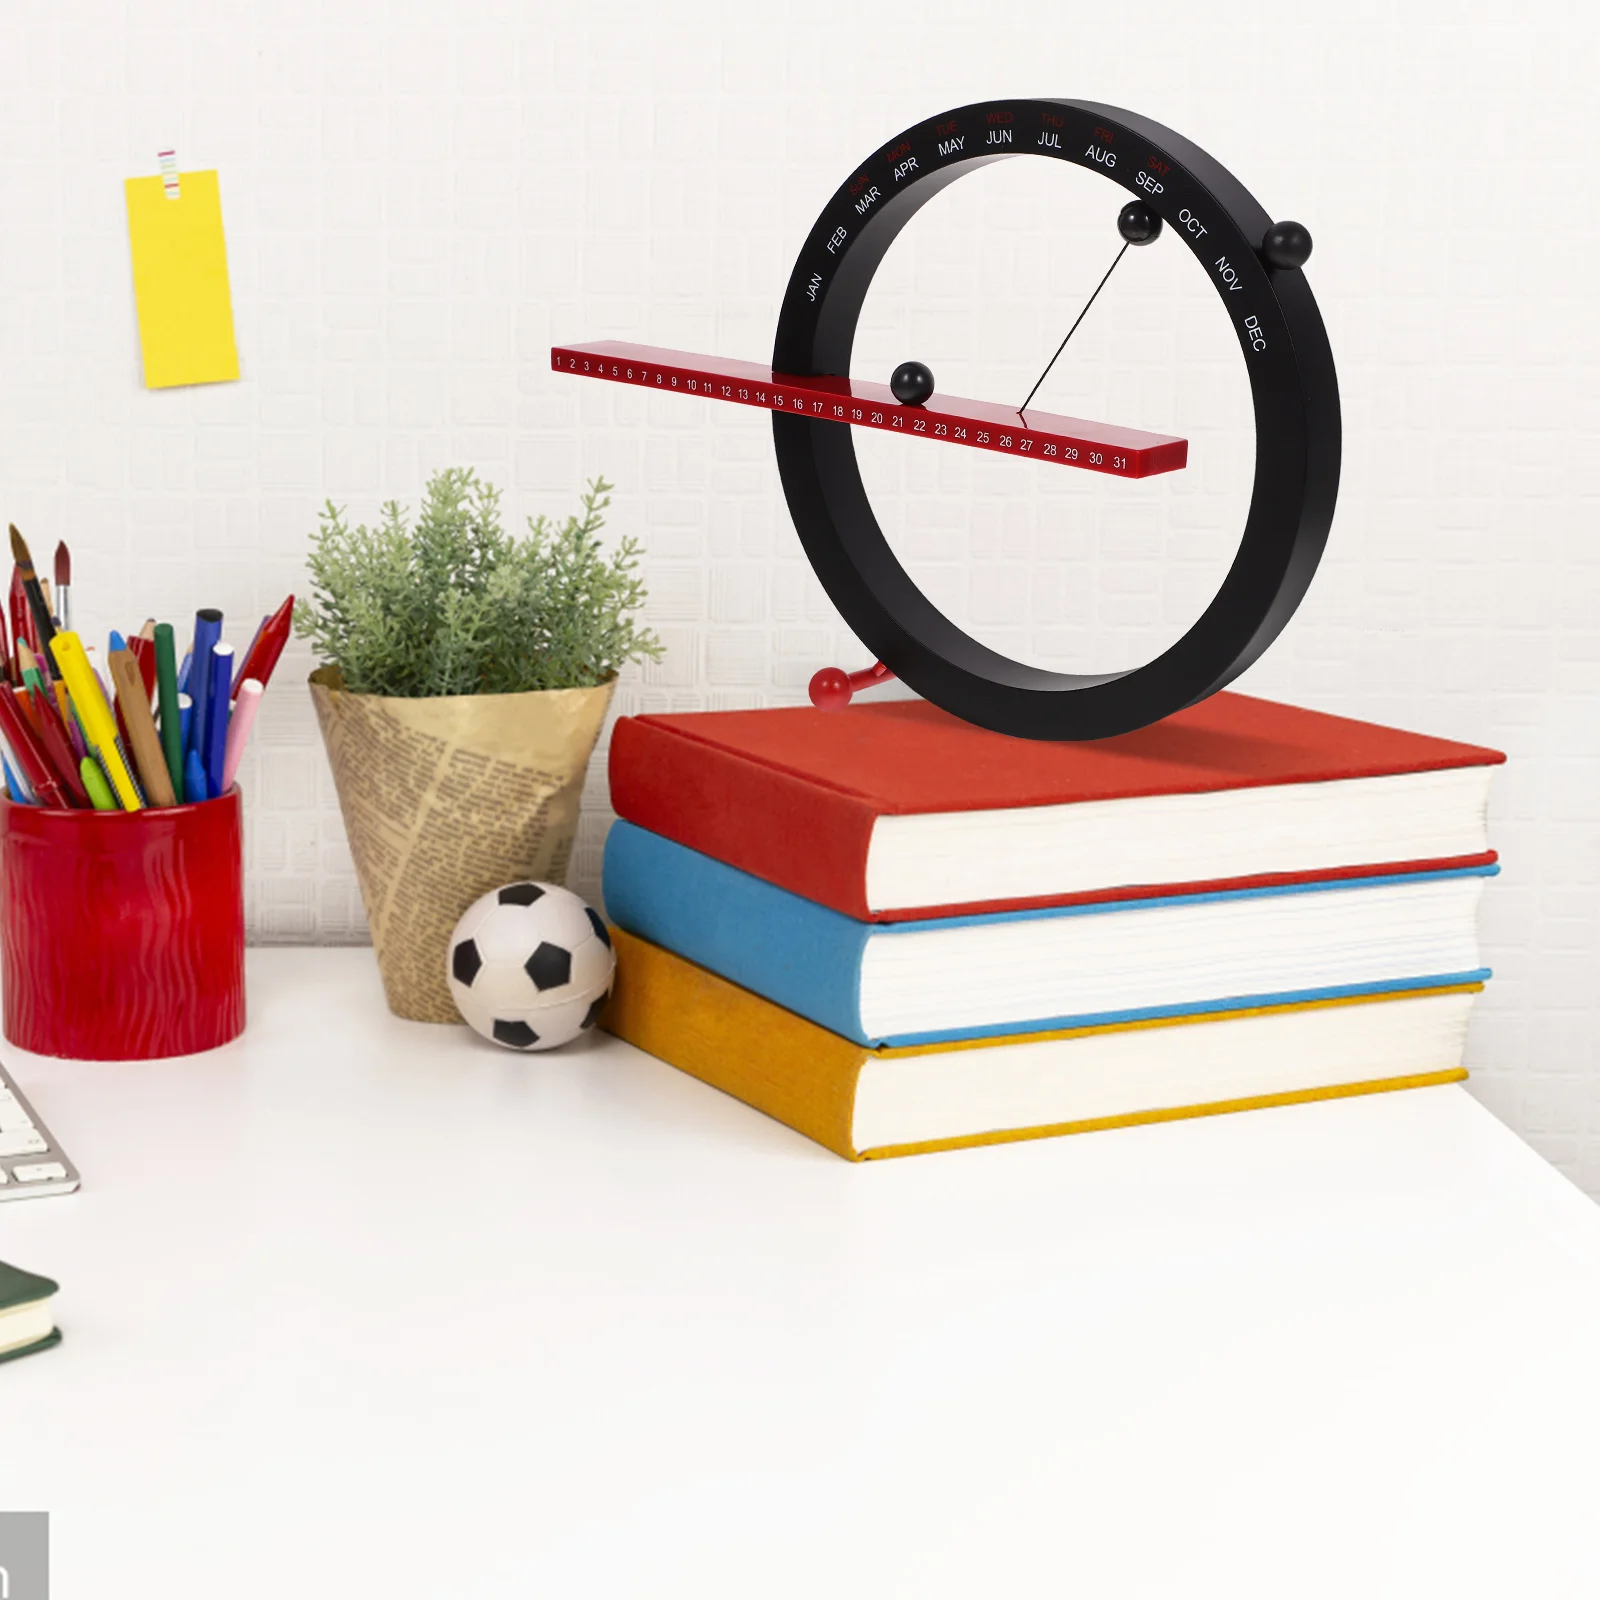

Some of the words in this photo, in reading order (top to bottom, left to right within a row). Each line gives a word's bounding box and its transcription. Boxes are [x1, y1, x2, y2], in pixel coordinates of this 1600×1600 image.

[849, 175, 870, 197] SUN
[886, 142, 911, 162] MON
[935, 119, 957, 135] TUE
[985, 111, 1013, 124] WED
[1041, 113, 1065, 128] THU
[1093, 127, 1115, 144] FRI
[1147, 155, 1170, 176] SAT
[806, 272, 823, 302] JAN
[826, 226, 847, 254] FEB
[854, 186, 882, 215] MAR
[894, 156, 920, 182] APR
[937, 135, 965, 157] MAY
[986, 129, 1012, 145] JUN
[1037, 131, 1062, 149] JUL
[1084, 144, 1117, 168] AUG
[1135, 170, 1164, 195] SEP
[1178, 208, 1208, 239] OCT
[1214, 255, 1243, 291] NOV
[1244, 314, 1267, 352] DEC
[556, 356, 561, 366] 1
[569, 358, 576, 369] 2
[584, 361, 590, 371] 3
[597, 363, 604, 374] 4
[612, 366, 618, 377] 5
[627, 368, 633, 379] 6
[641, 371, 647, 381] 7
[656, 373, 662, 385] 8
[671, 376, 677, 387] 9
[686, 379, 697, 391] 10
[703, 382, 712, 393] 11
[721, 385, 732, 397] 12
[738, 388, 749, 400] 13
[755, 391, 766, 403] 14
[772, 394, 784, 407] 15
[792, 398, 803, 410] 16
[812, 401, 824, 413] 17
[832, 405, 844, 417] 18
[851, 408, 863, 421] 19
[870, 411, 883, 424] 20
[891, 415, 903, 428] 21
[913, 419, 926, 432] 22
[934, 423, 947, 436] 23
[954, 426, 967, 440] 24
[976, 430, 990, 444] 25
[999, 434, 1013, 448] 26
[1019, 438, 1034, 452] 27
[1043, 443, 1057, 456] 28
[1064, 447, 1079, 461] 29
[1089, 451, 1103, 465] 30
[1113, 456, 1126, 470] 31
